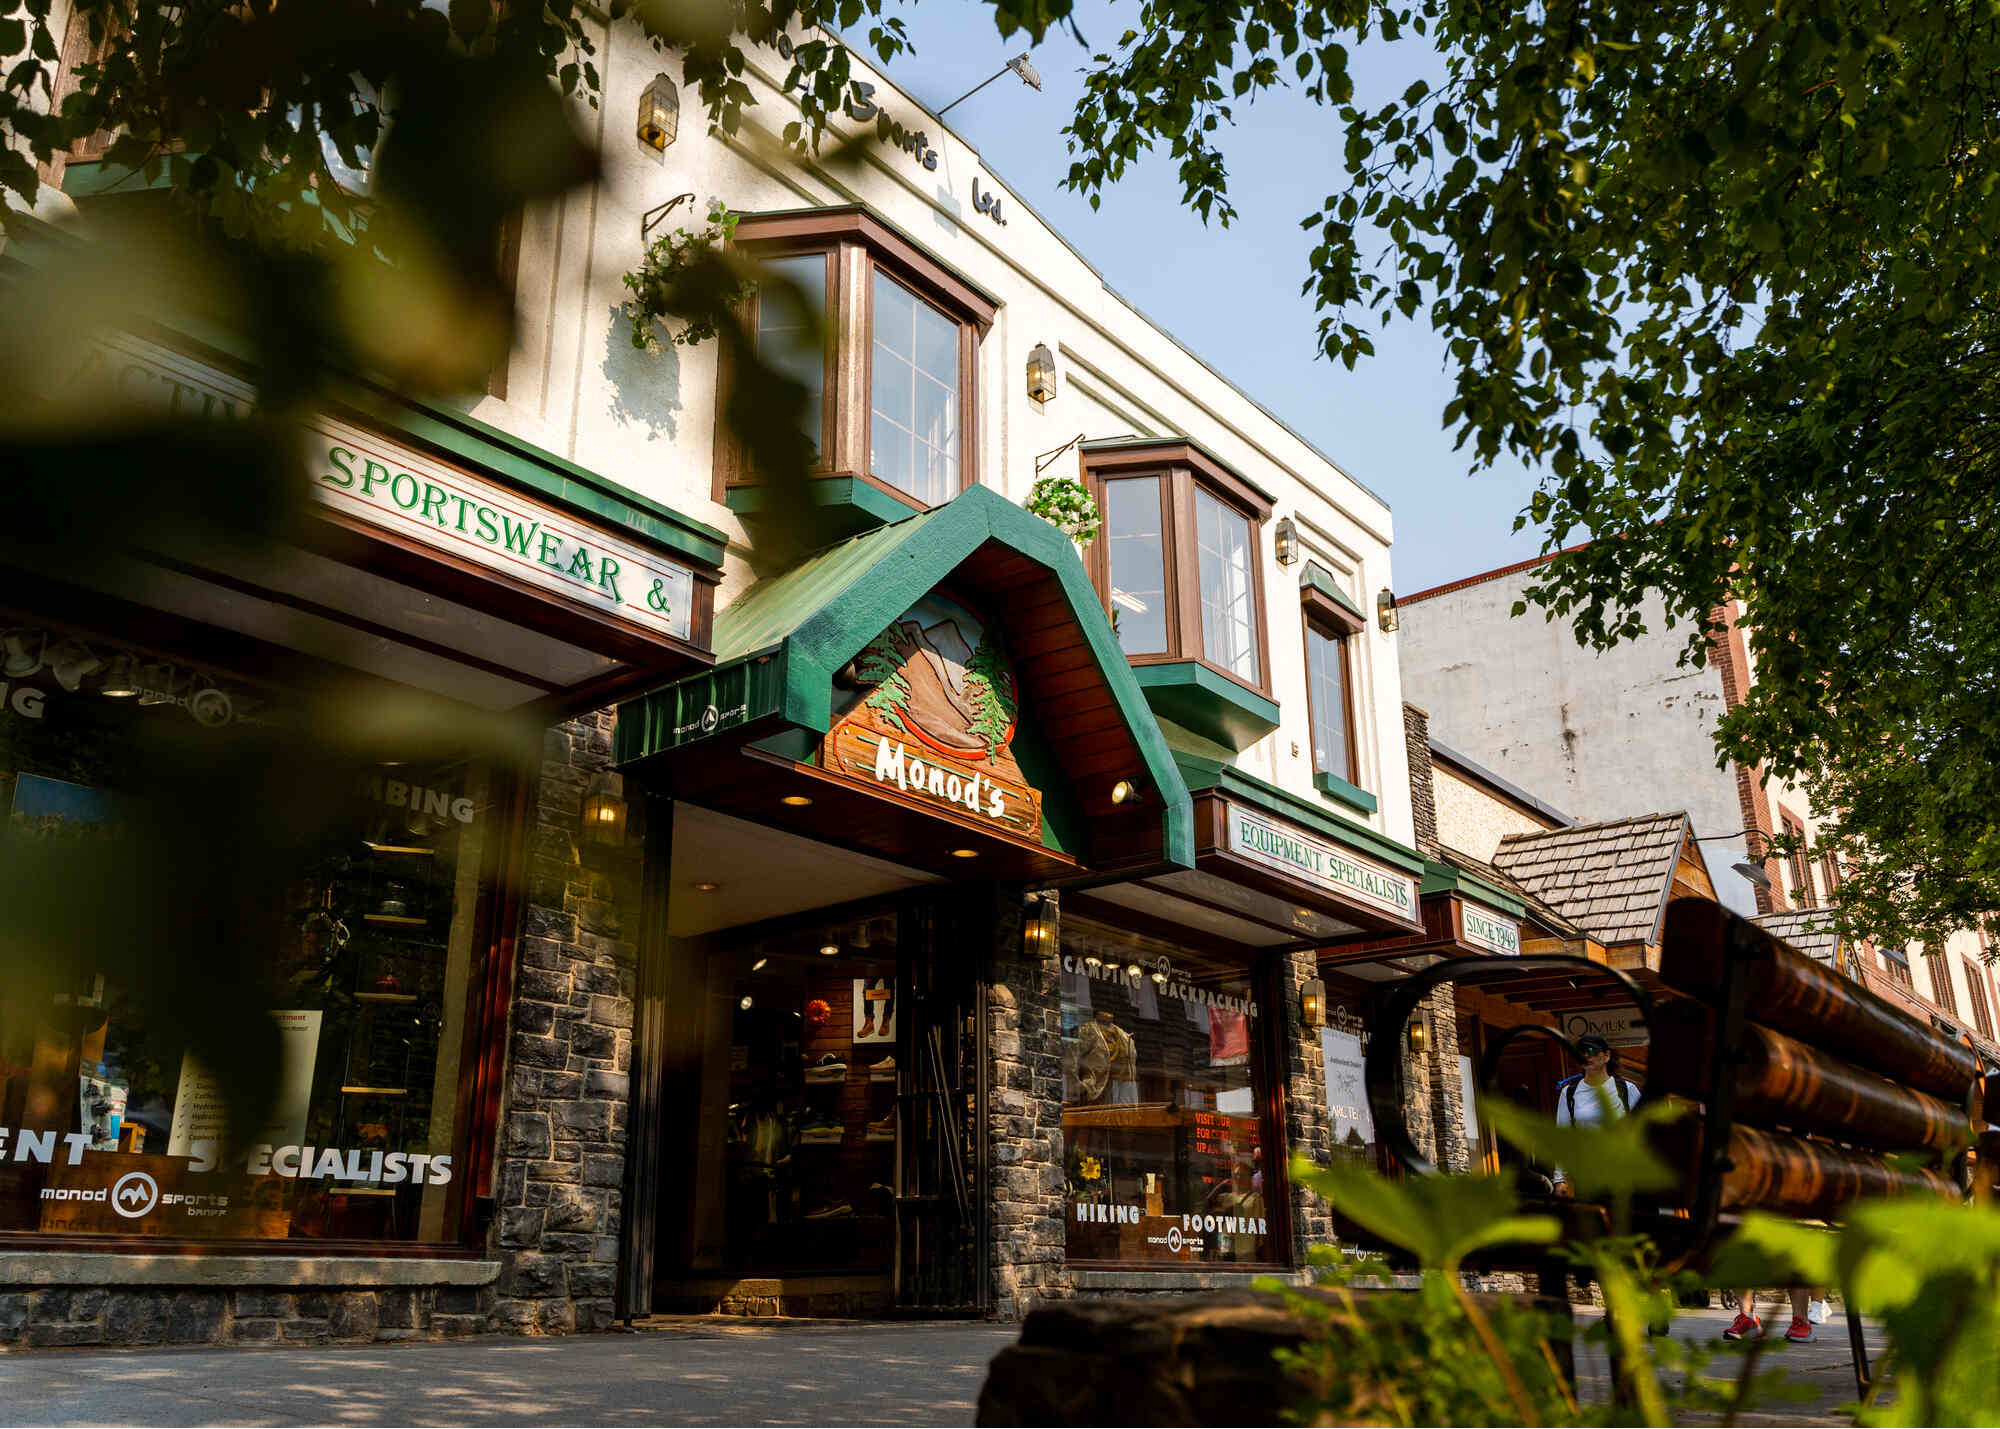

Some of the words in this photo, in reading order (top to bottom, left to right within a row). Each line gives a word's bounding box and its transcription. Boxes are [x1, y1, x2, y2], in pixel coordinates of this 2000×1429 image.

[971, 176, 1008, 227] Ltd.
[321, 446, 626, 604] SPORTSWEAR
[647, 577, 671, 614] &
[875, 736, 1006, 818] Monod's
[1240, 820, 1323, 874] EQUIPMENT
[1328, 857, 1409, 907] SPECIALISTS
[1467, 912, 1496, 942] SINCE
[1496, 926, 1517, 951] 1949
[1159, 981, 1258, 1018] BACKPACKING
[188, 1141, 454, 1186] SECIALISTS
[40, 1188, 108, 1203] monod
[161, 1193, 229, 1207] sports
[1076, 1203, 1141, 1225] HIKING
[1183, 1214, 1268, 1236] FOOTWEAR
